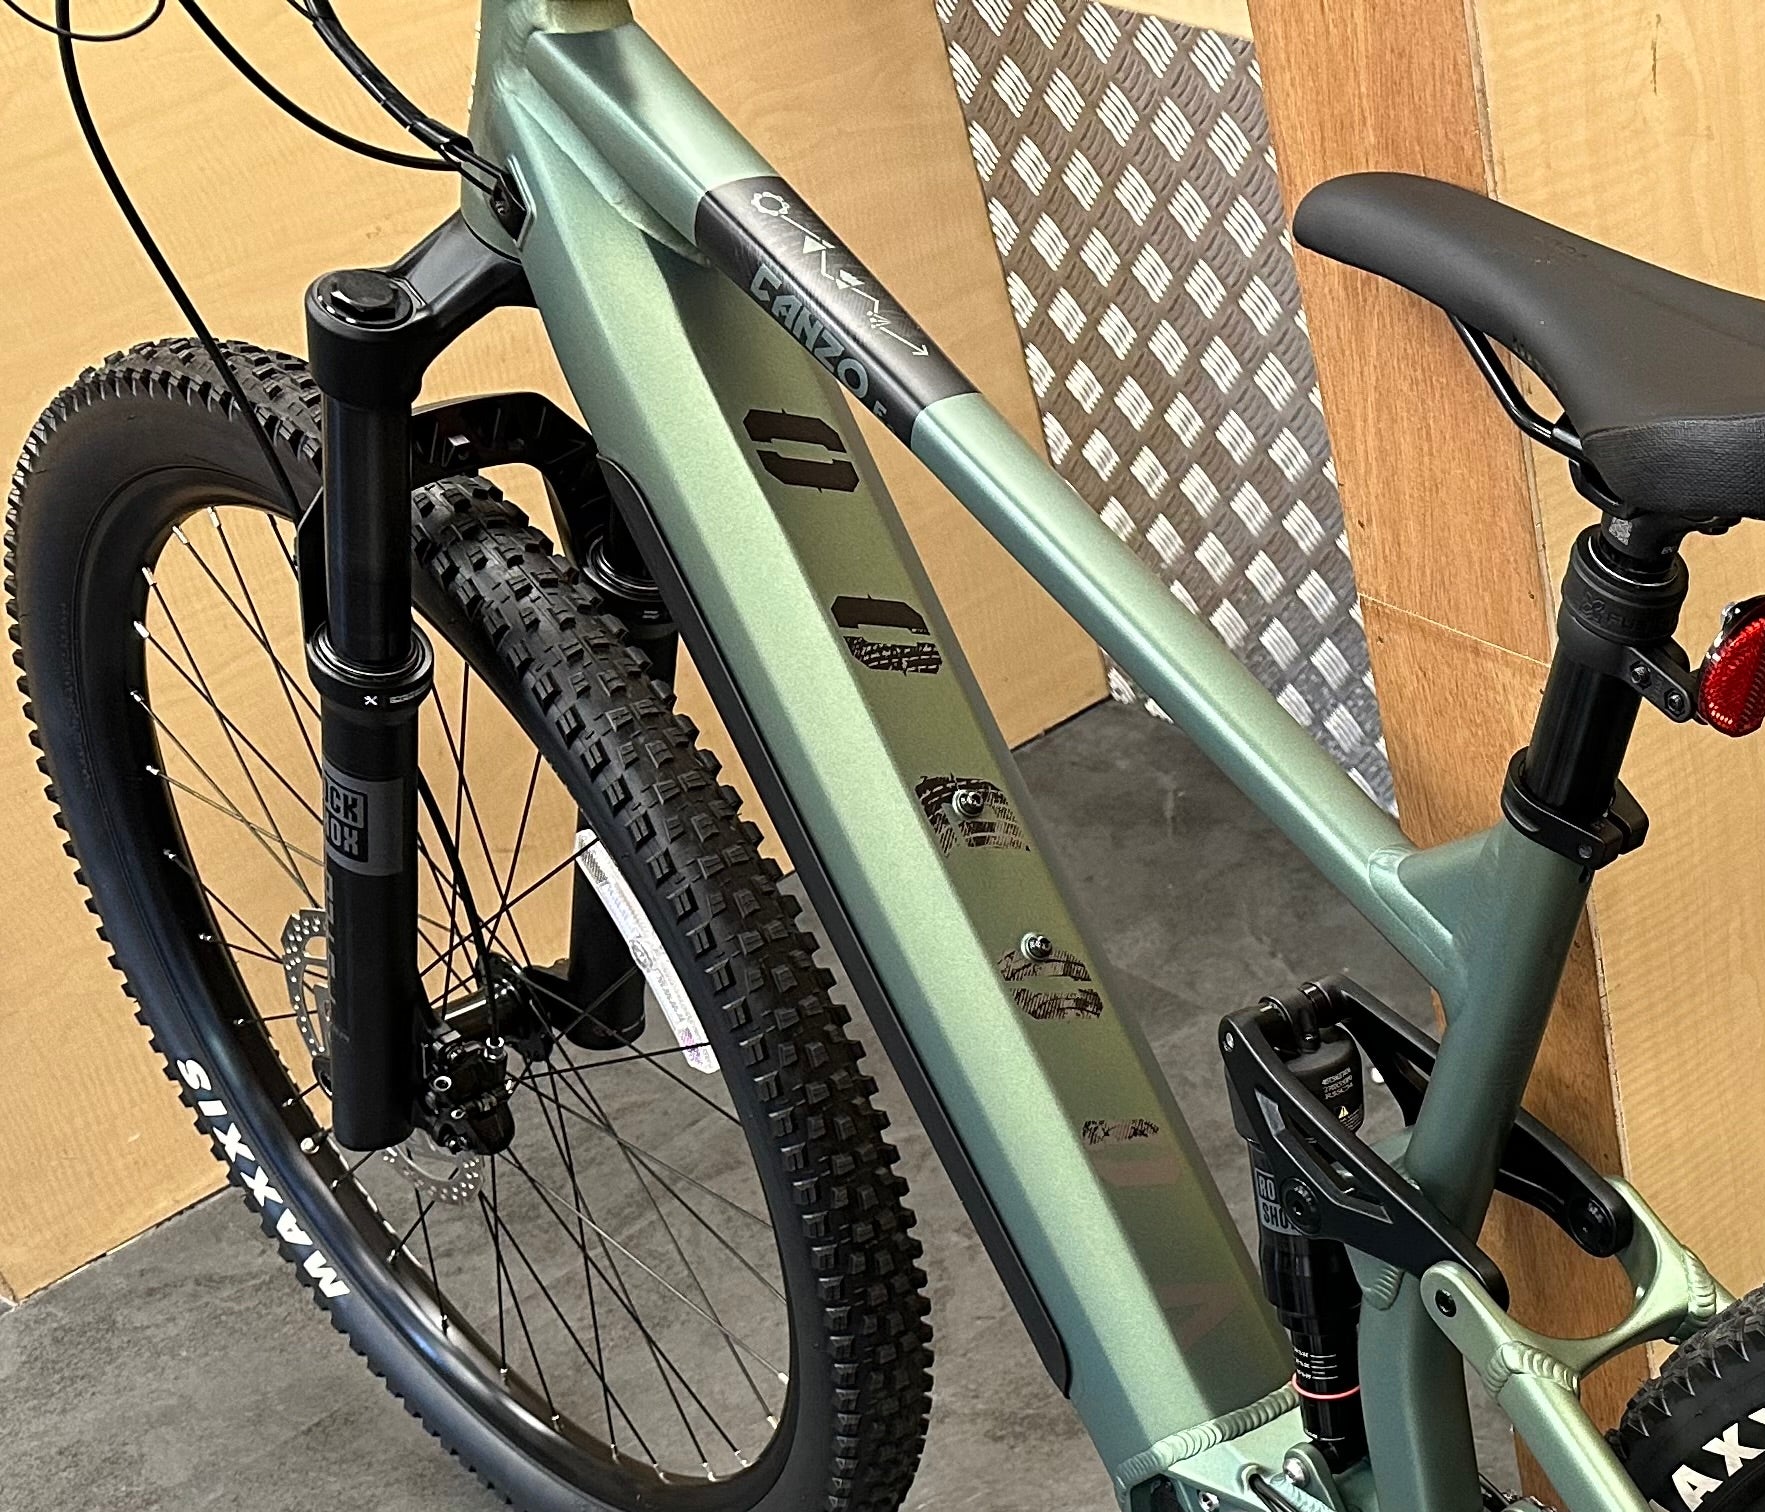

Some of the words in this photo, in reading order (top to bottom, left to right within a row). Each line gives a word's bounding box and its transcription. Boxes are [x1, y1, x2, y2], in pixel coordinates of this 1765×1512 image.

[750, 262, 870, 399] CANZO
[176, 1059, 350, 1298] MAXXIS
[1263, 1202, 1294, 1229] SHO
